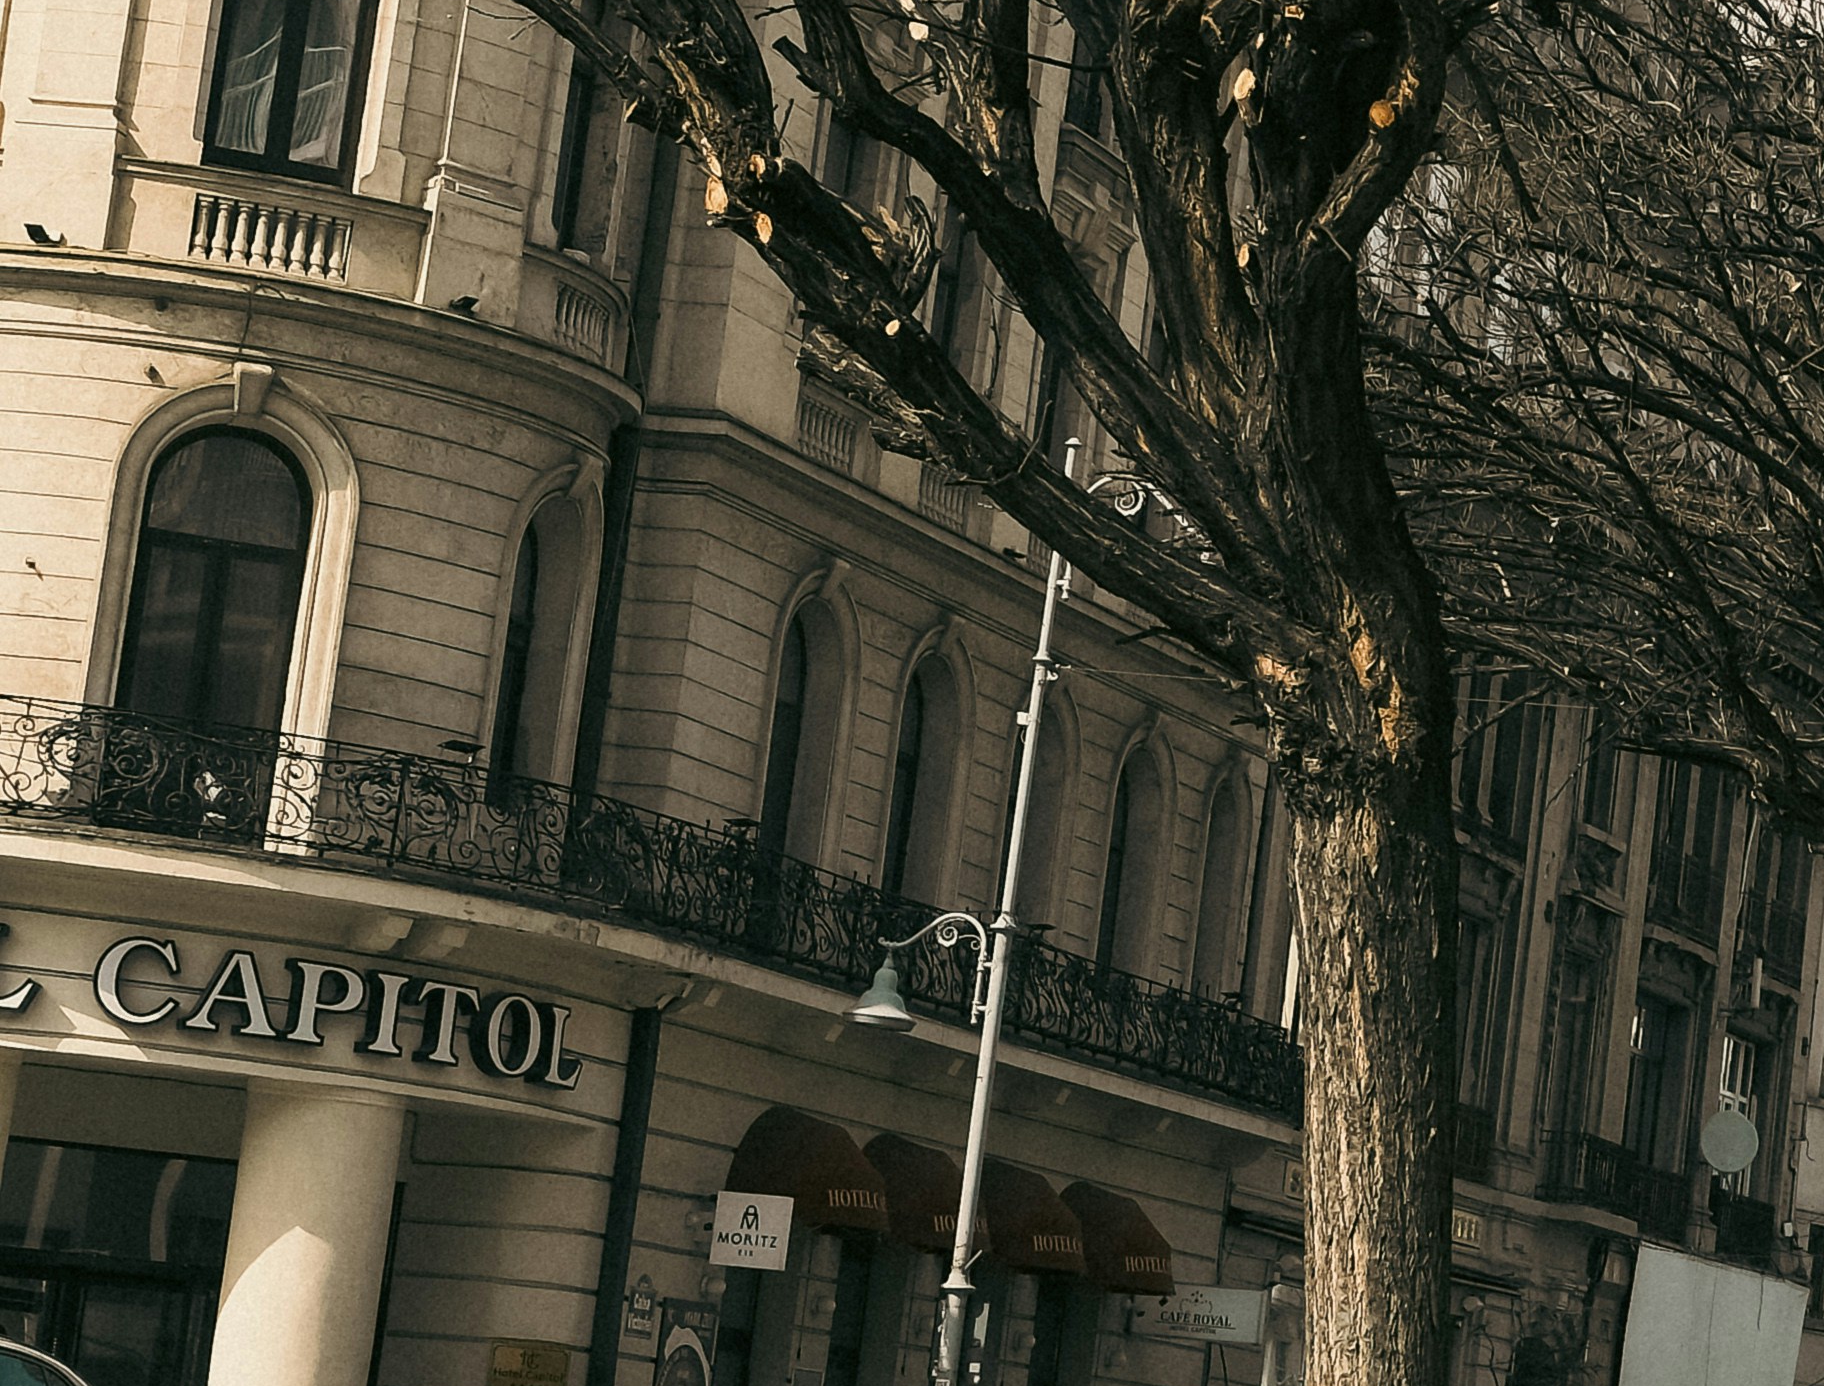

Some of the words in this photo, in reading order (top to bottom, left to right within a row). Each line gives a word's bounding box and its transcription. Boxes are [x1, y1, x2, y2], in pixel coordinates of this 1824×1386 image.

[94, 935, 585, 1090] CAPITOL
[828, 1188, 874, 1208] HOTEL
[717, 1231, 778, 1249] MORITZ
[1033, 1234, 1073, 1253] HOTEL
[1125, 1255, 1161, 1273] HOTEL
[1193, 1313, 1232, 1328] ROYAL
